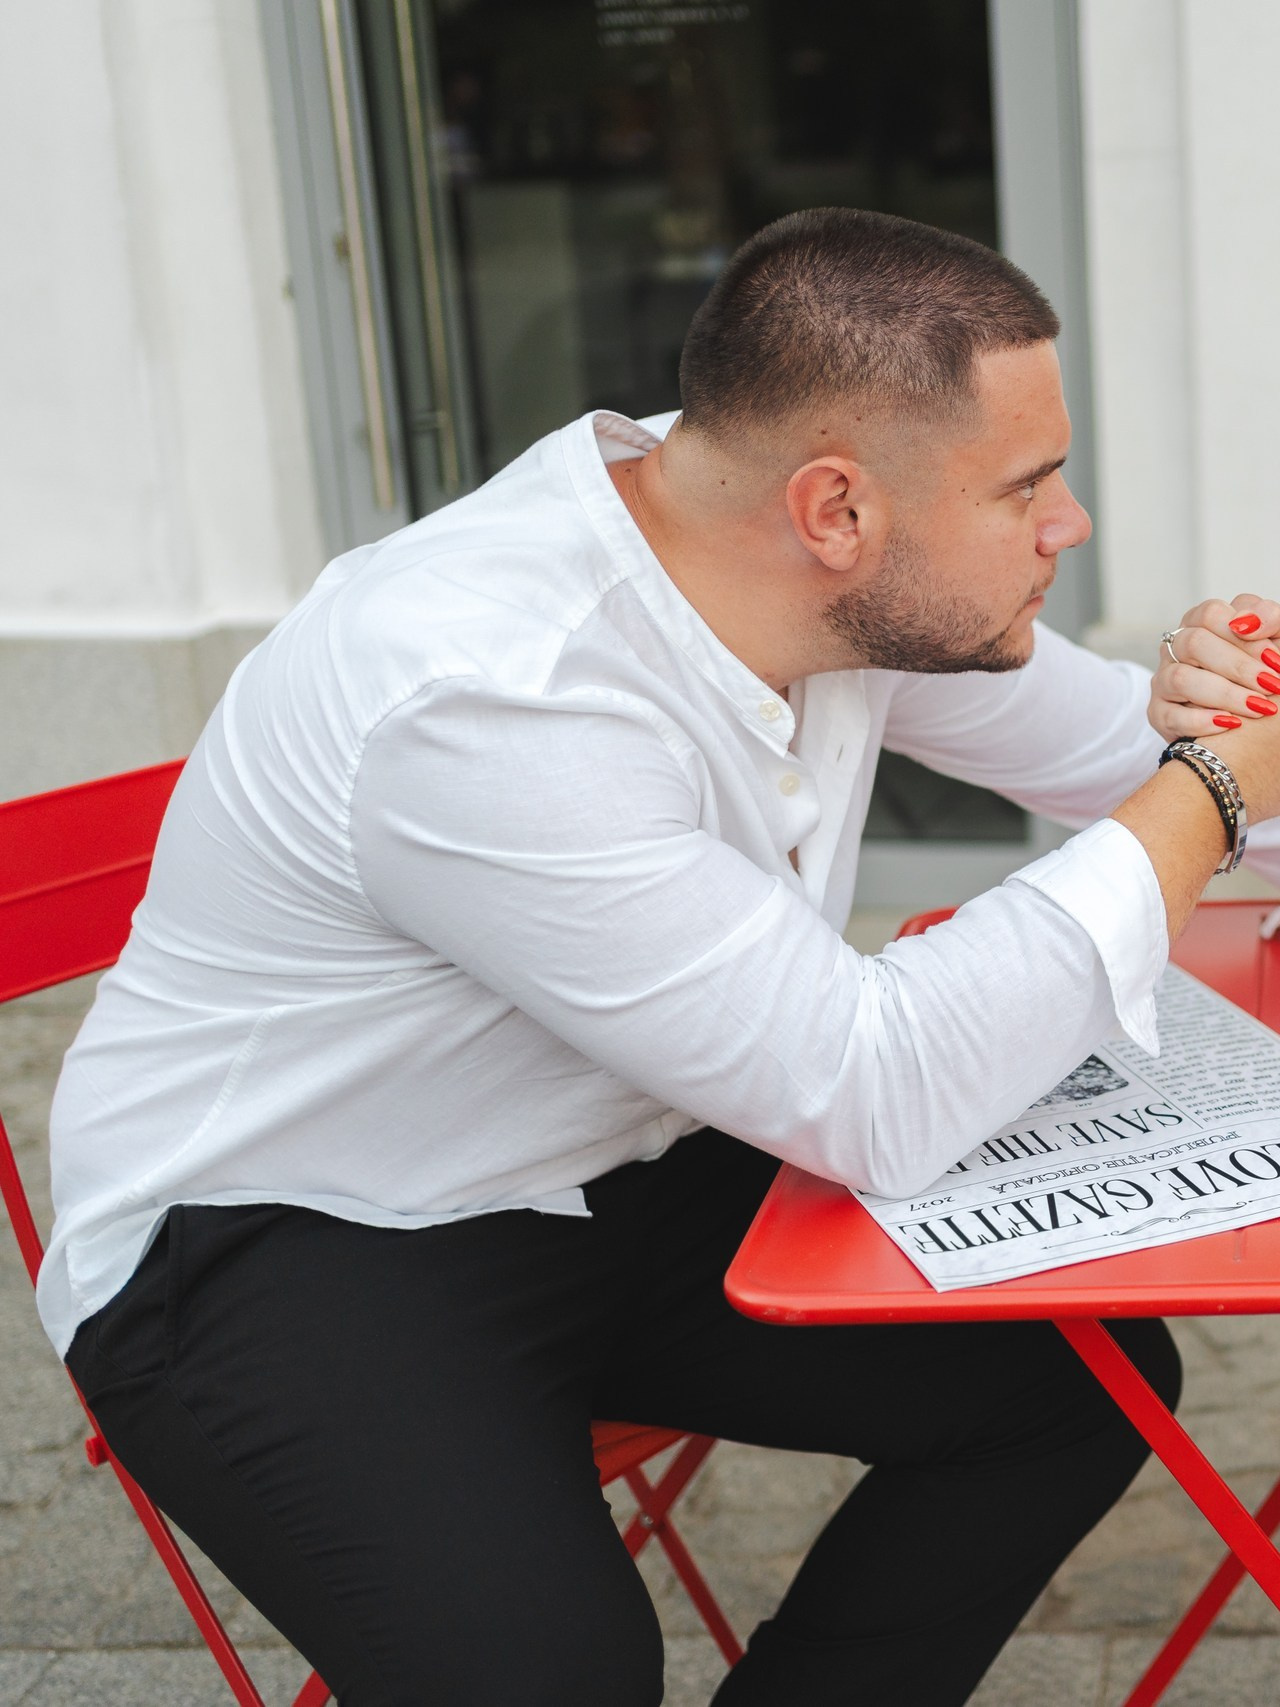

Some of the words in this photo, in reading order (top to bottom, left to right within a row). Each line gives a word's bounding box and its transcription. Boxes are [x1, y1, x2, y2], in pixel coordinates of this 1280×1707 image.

[1055, 1102, 1184, 1147] SAVE
[979, 1129, 1062, 1167] THE
[897, 1179, 1155, 1254] GAZETTE
[909, 1195, 955, 1212] 2027
